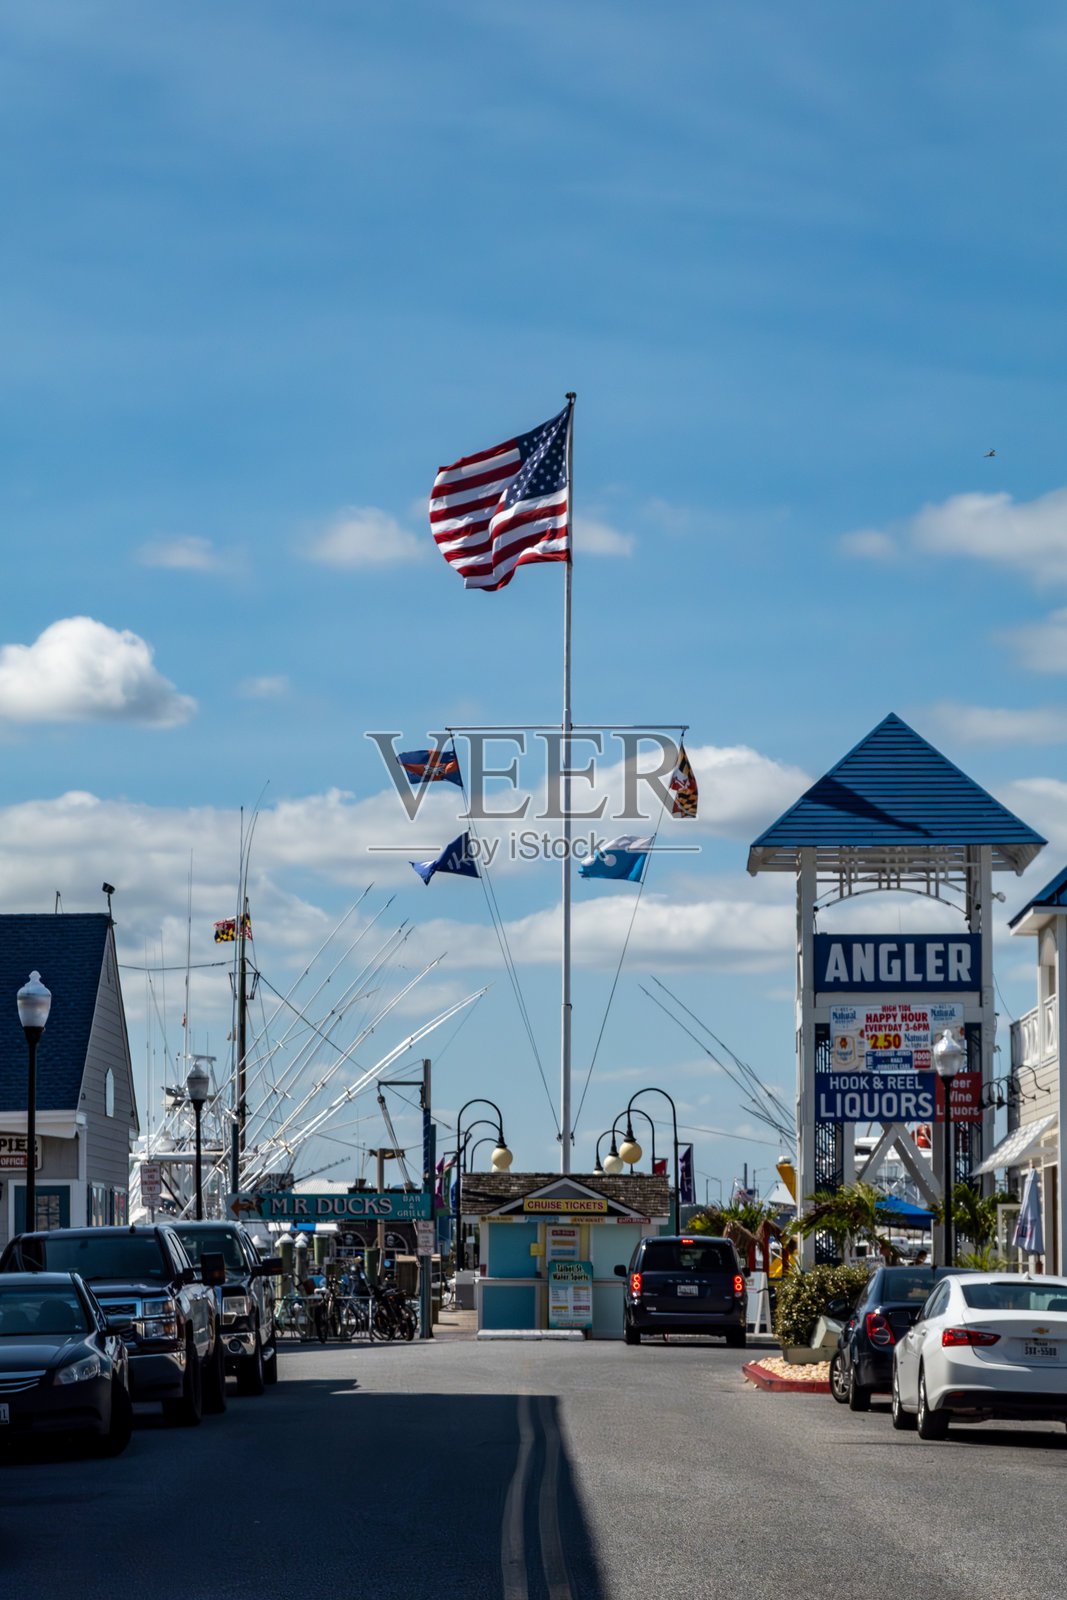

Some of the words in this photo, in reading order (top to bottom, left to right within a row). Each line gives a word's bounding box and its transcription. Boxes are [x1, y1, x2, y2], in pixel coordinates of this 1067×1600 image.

[824, 943, 972, 982] ANGLER
[898, 1004, 911, 1012] TIDE
[865, 1013, 898, 1023] HAPPY
[901, 1012, 928, 1022] HOUR
[865, 1023, 902, 1032] EVERYDAY
[904, 1022, 930, 1032] 3-6PM
[904, 1033, 929, 1042] Natural
[829, 1076, 870, 1089] HOOK
[872, 1076, 884, 1089] &
[888, 1076, 923, 1089] REEL
[820, 1093, 933, 1118] LIQUORS
[936, 1104, 980, 1119] Lquors
[1, 1157, 25, 1166] OFFICE
[402, 1195, 421, 1203] BAR
[316, 1197, 393, 1215] DUCKS
[527, 1201, 562, 1210] CRUISE
[564, 1201, 604, 1210] TICKETS
